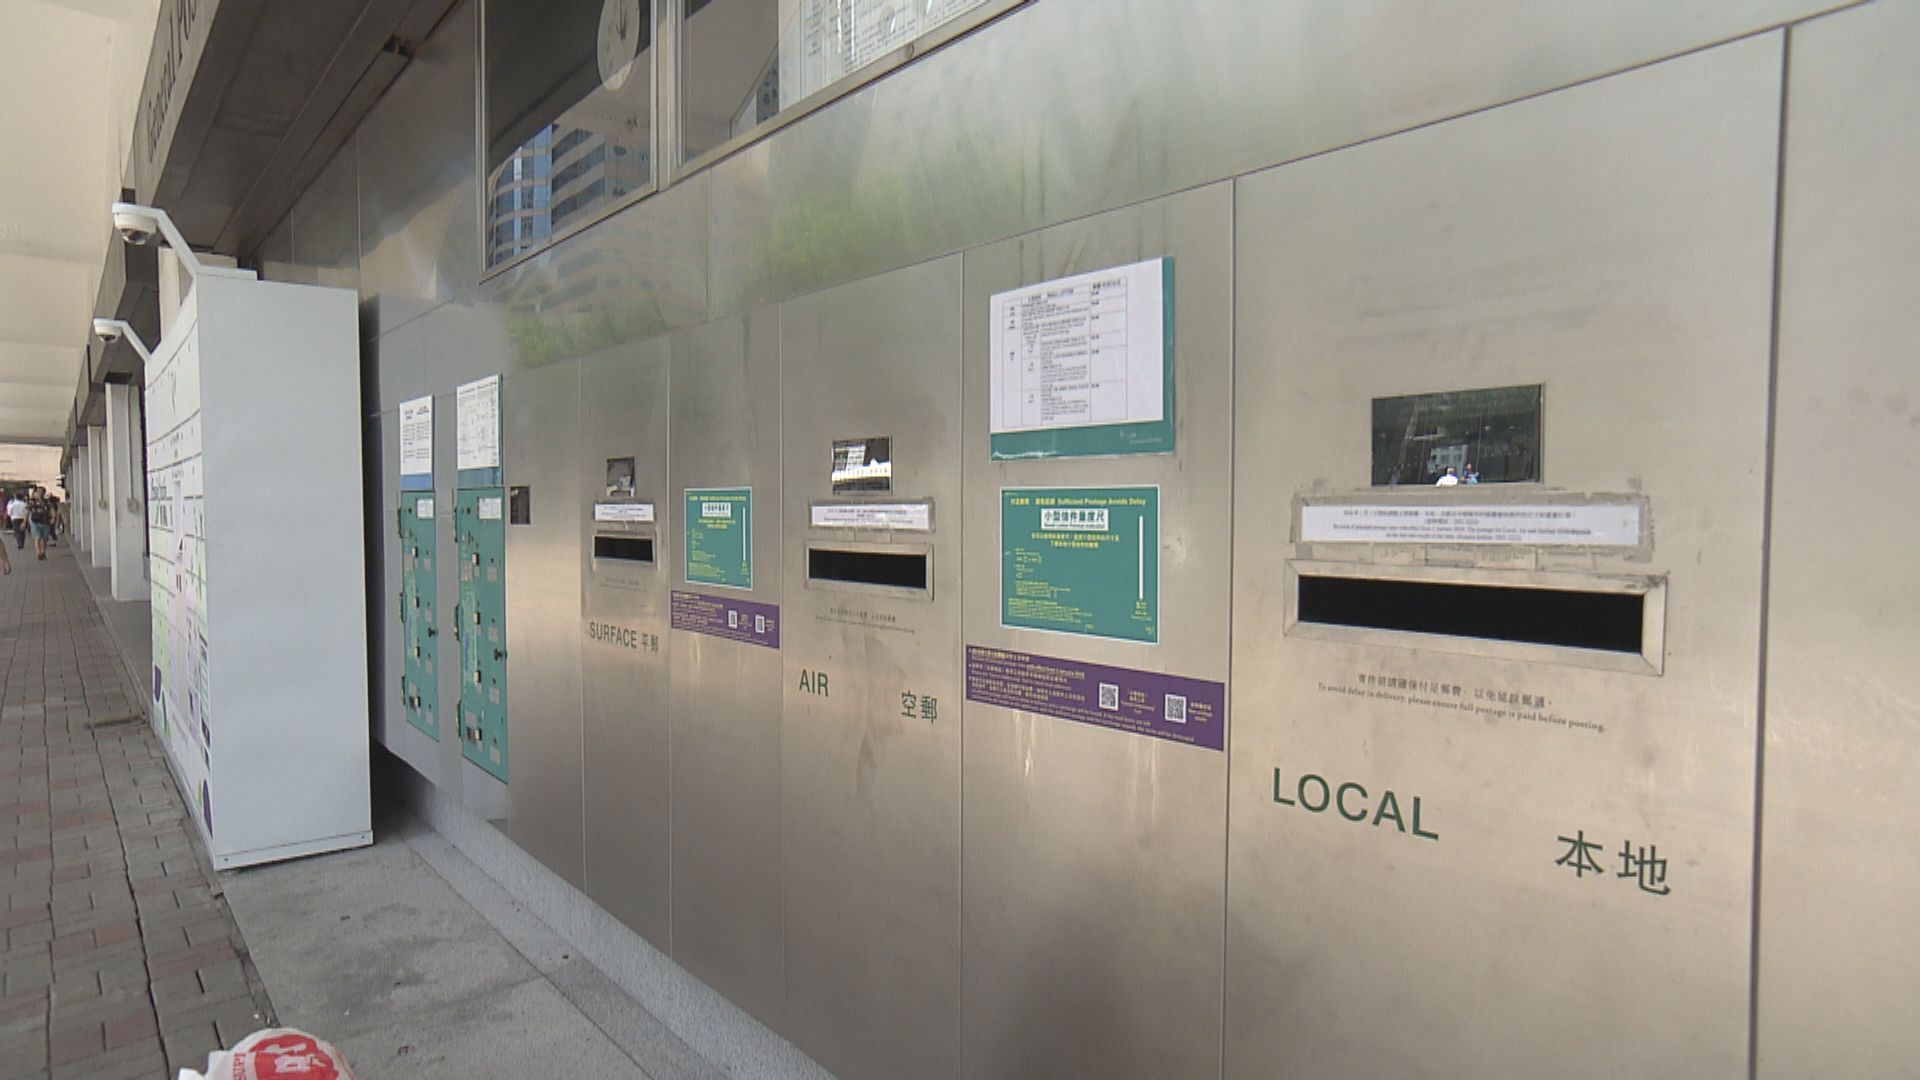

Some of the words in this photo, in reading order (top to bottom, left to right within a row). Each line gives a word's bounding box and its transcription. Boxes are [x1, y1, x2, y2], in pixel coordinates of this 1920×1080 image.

[147, 11, 176, 163] General
[1044, 510, 1105, 523] 小型信件量度尺
[1084, 498, 1107, 508] Postage
[1108, 498, 1128, 506] Avoids
[1129, 498, 1147, 507] Delay
[589, 621, 637, 649] SURFACE
[799, 668, 829, 697] AIR
[901, 690, 938, 724] 空郵
[1317, 681, 1326, 690] To
[1327, 685, 1346, 694] avoid
[1347, 687, 1366, 697] delay
[1407, 695, 1431, 706] please
[1432, 700, 1458, 709] ensure
[1459, 702, 1474, 712] full
[1475, 706, 1506, 719] postage
[1517, 711, 1536, 721] paid
[1538, 713, 1567, 725] before
[1272, 766, 1439, 841] LOCAL
[1554, 829, 1671, 896] 本地
